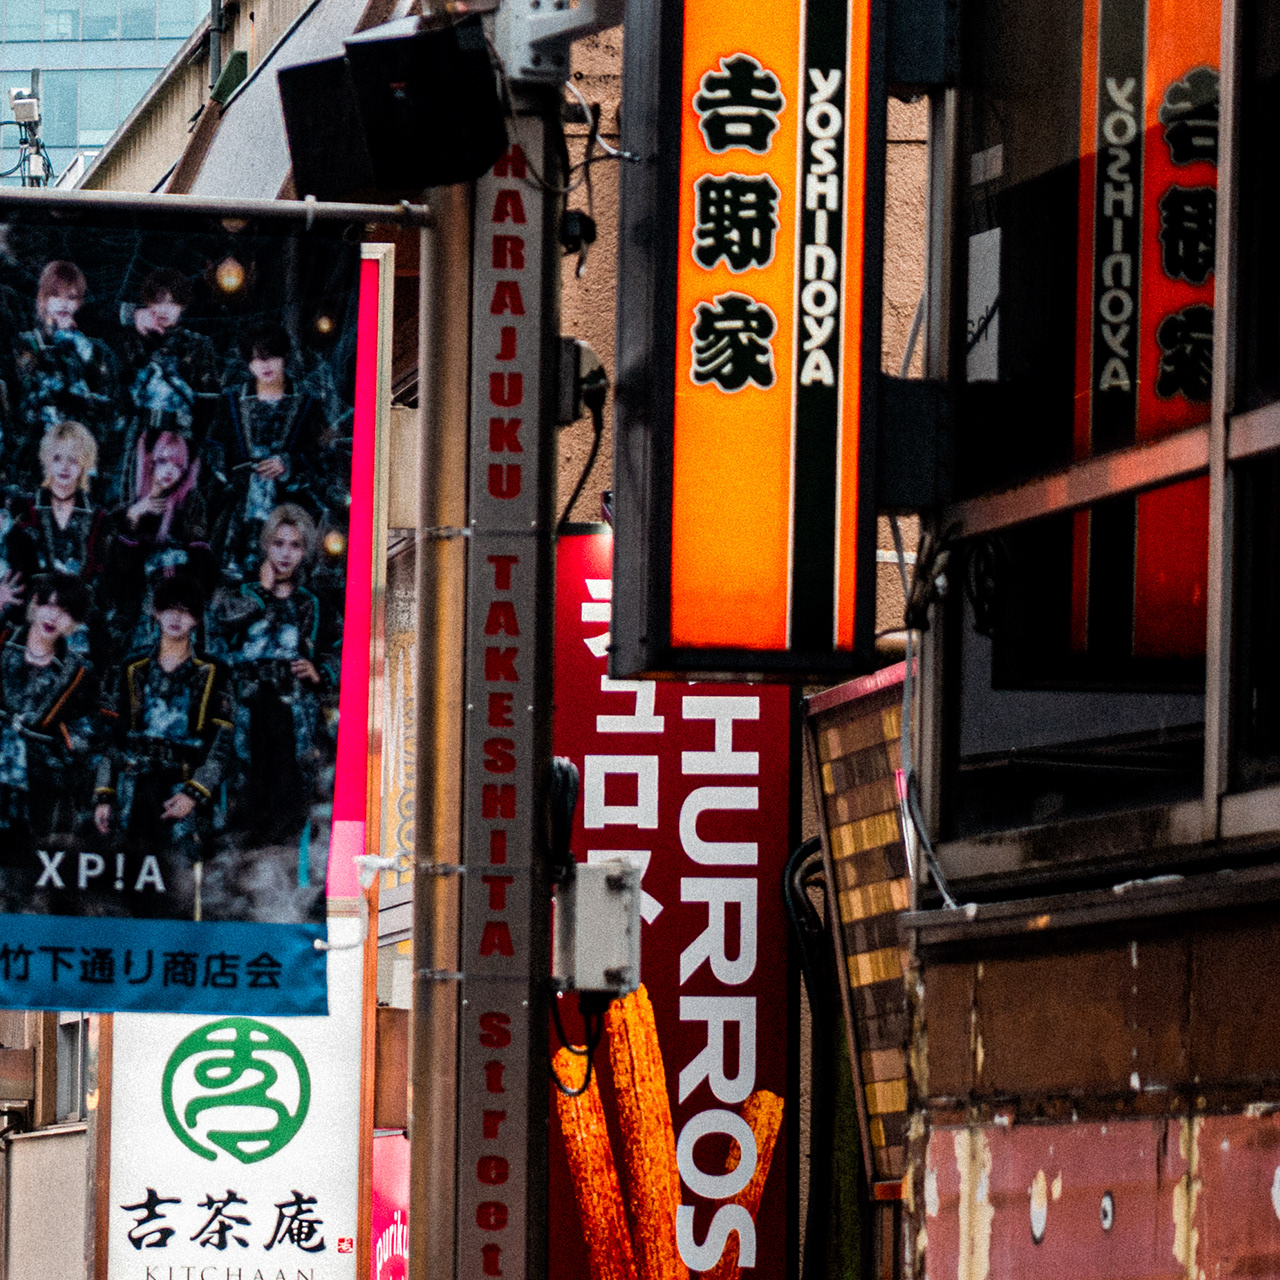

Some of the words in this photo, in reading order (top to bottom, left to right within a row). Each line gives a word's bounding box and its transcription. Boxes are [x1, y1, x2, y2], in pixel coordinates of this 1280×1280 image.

[487, 143, 527, 500] HARAJUKU
[692, 53, 786, 393] 吉野家
[35, 849, 167, 893] XP!A
[479, 554, 521, 957] TAKESHITA
[676, 680, 761, 1272] HURROS
[120, 1187, 327, 1253] 吉茶庵
